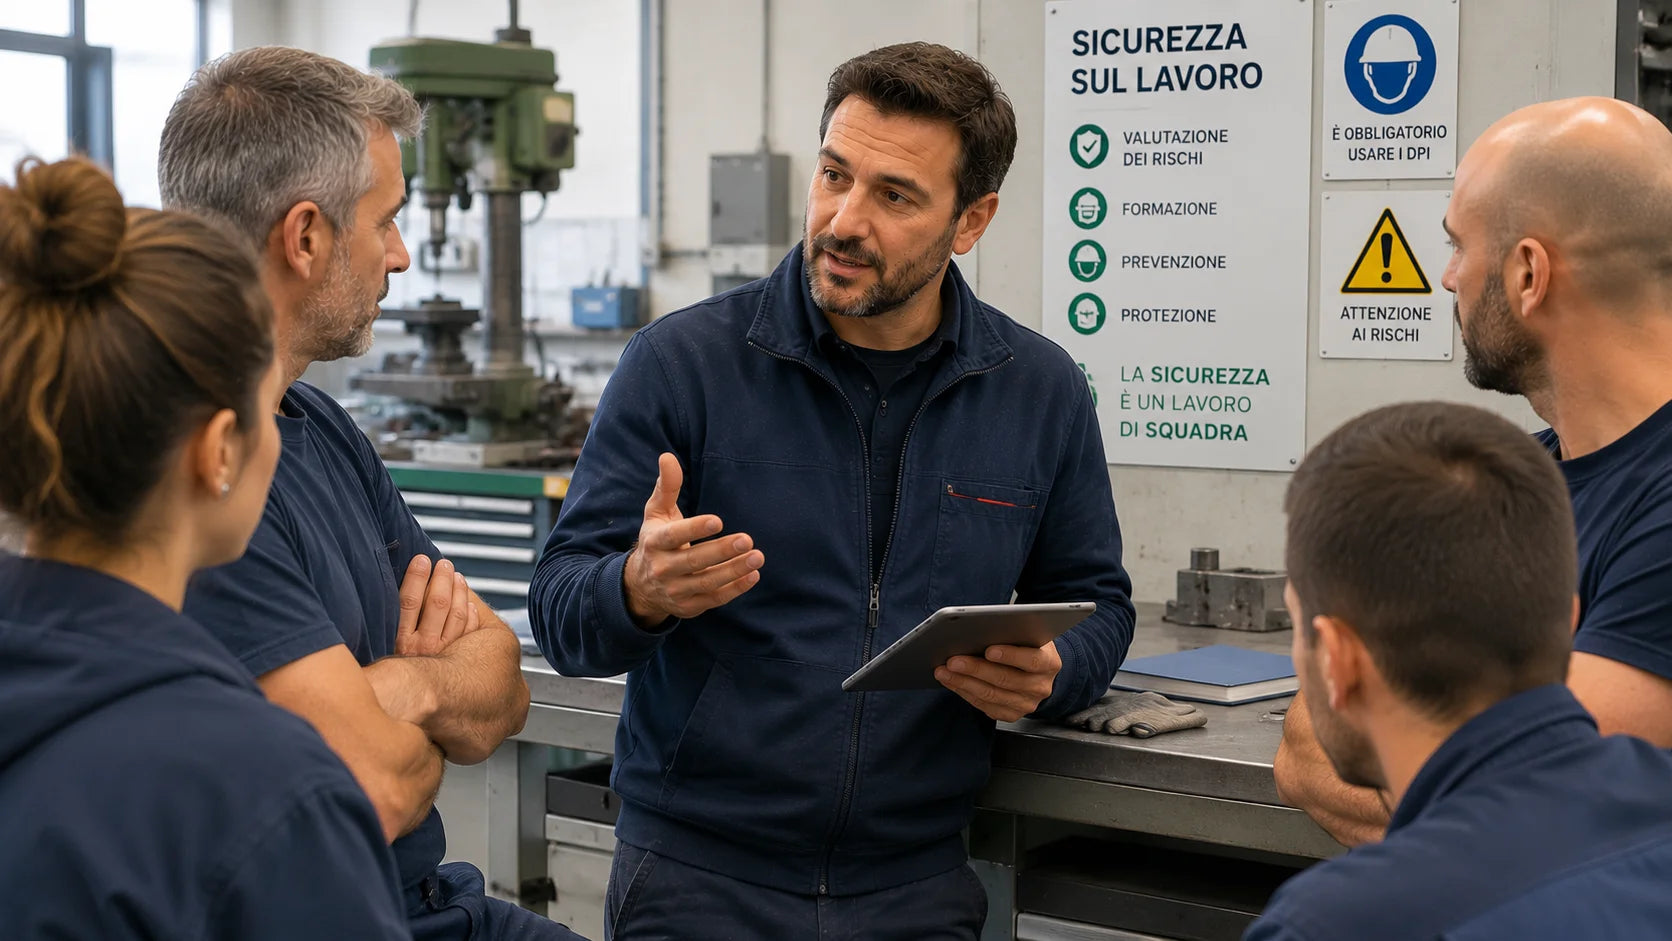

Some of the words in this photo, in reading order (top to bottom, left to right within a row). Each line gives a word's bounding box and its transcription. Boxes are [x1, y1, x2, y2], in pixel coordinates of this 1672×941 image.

[1072, 23, 1247, 56] SICUREZZA
[1072, 68, 1127, 94] SUL
[1137, 62, 1262, 92] LAVORO
[1124, 130, 1228, 144] VALUTAZIONE
[1333, 125, 1340, 140] È
[1345, 125, 1447, 140] OBBLIGATORIO
[1124, 153, 1147, 166] DEI
[1153, 152, 1202, 165] RISCHI
[1349, 147, 1394, 161] USARE
[1399, 147, 1402, 160] I
[1407, 147, 1429, 160] DPI
[1123, 202, 1217, 215] FORMAZIONE
[1122, 256, 1226, 268] PREVENZIONE
[1122, 309, 1216, 322] PROTEZIONE
[1341, 307, 1431, 320] ATTENZIONE
[1352, 328, 1365, 340] AI
[1371, 328, 1418, 341] RISCHI
[1122, 366, 1144, 382] LA
[1152, 366, 1269, 385] SICUREZZA
[1121, 390, 1130, 409] È
[1138, 394, 1164, 410] UN
[1173, 395, 1251, 412] LAVORO
[1121, 421, 1138, 437] DI
[1146, 422, 1247, 441] SQUADRA
